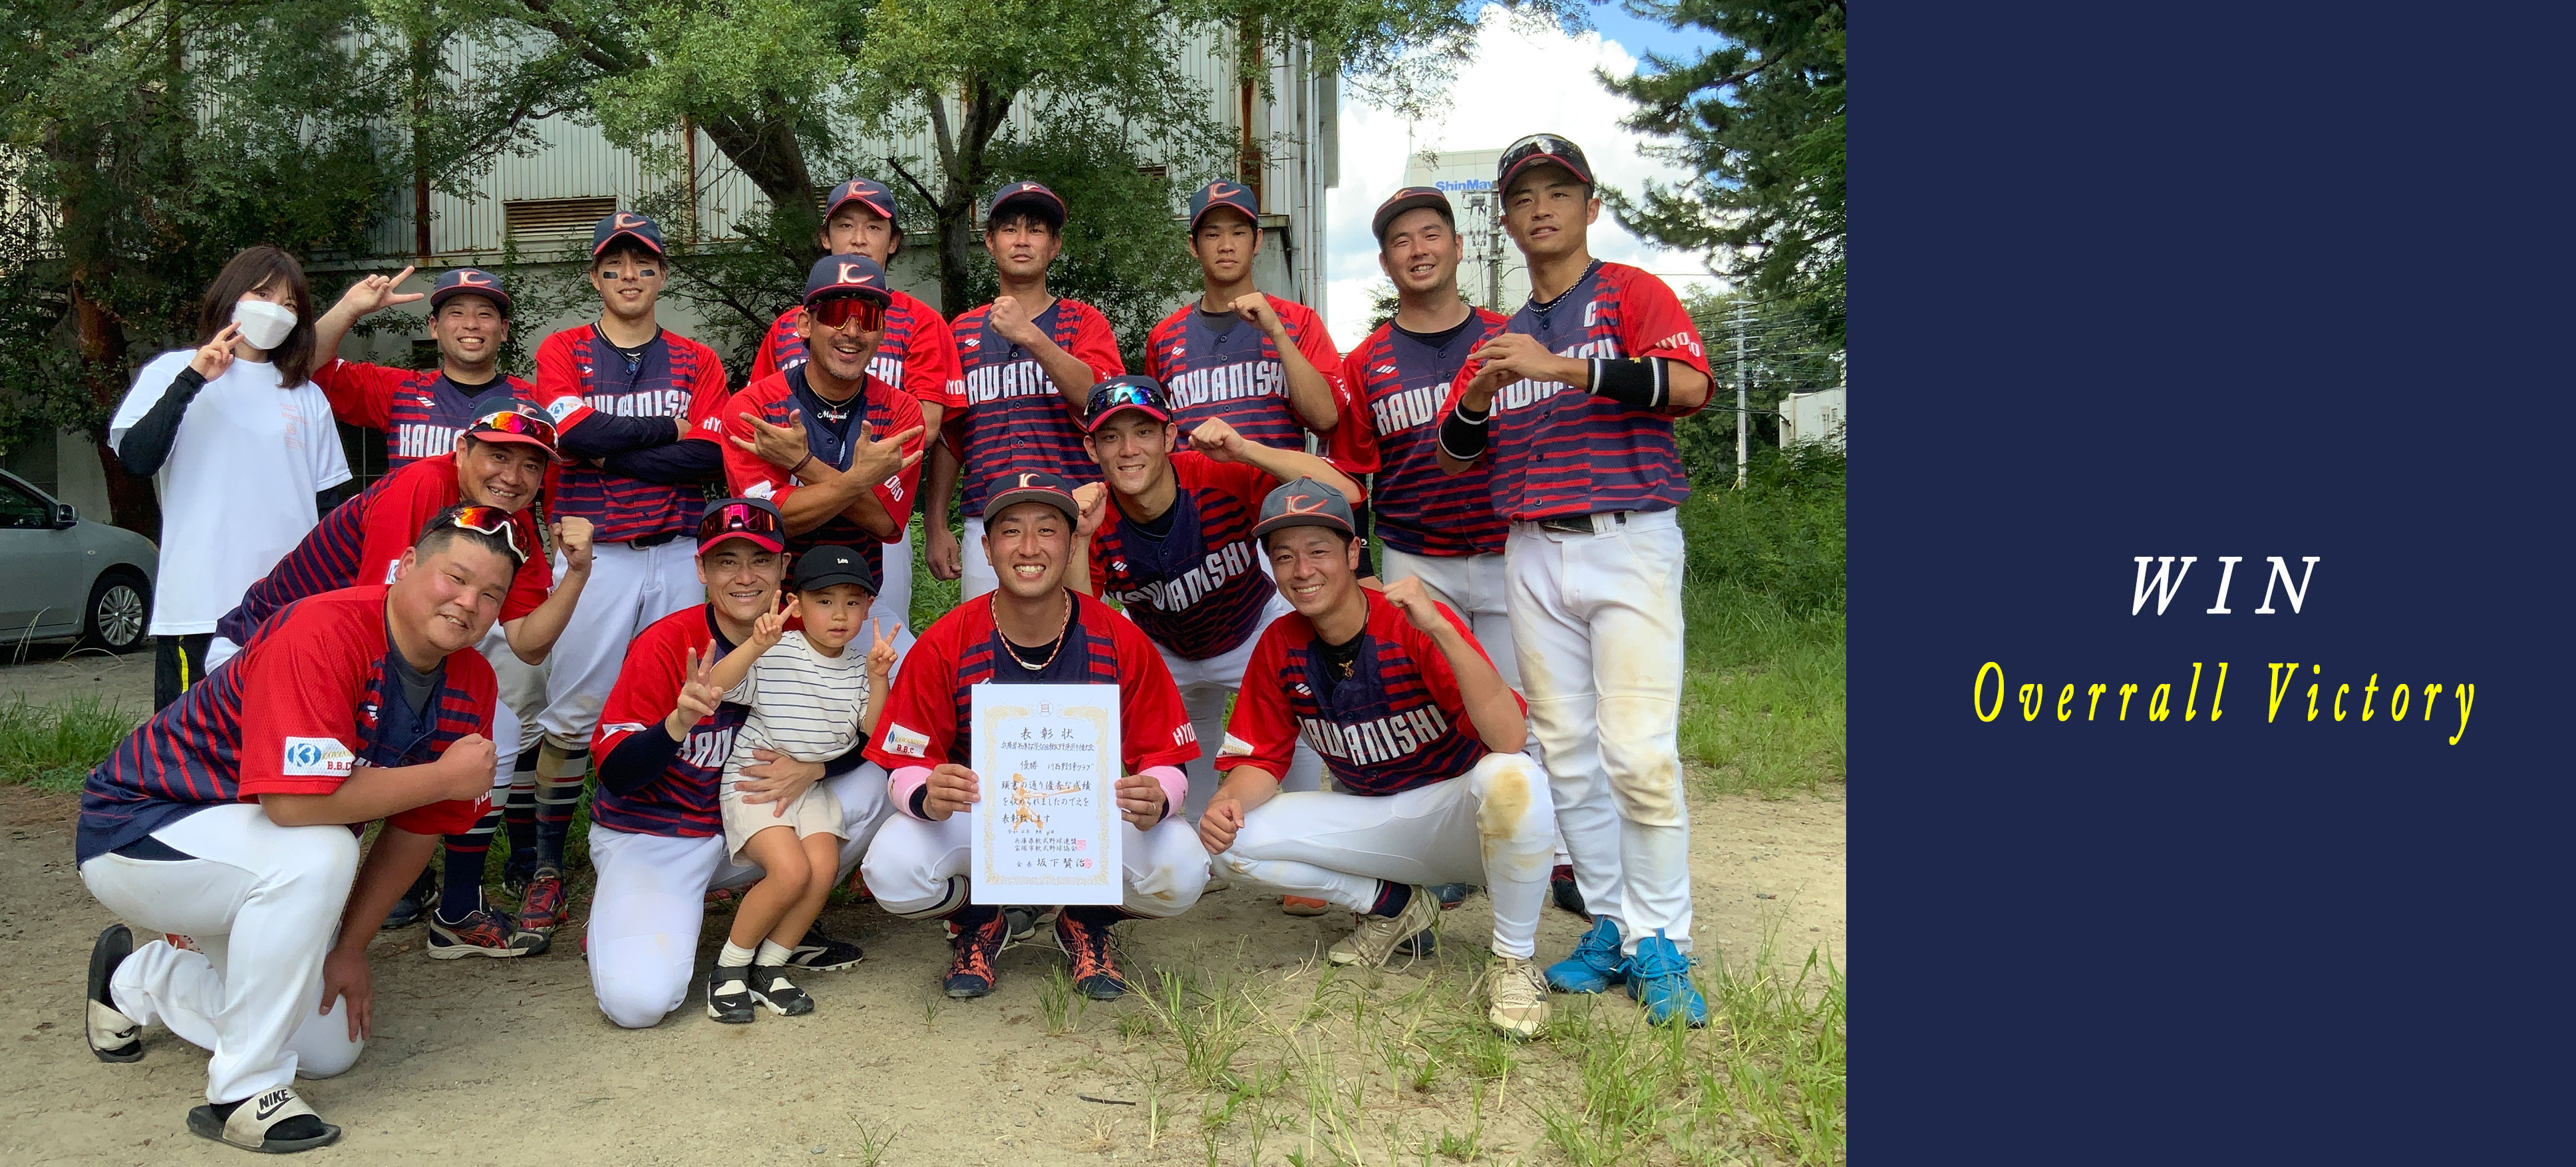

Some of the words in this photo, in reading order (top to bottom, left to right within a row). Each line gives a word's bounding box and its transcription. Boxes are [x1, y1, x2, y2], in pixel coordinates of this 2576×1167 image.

[1583, 301, 1597, 328] C
[703, 416, 723, 434] HY
[1021, 727, 1074, 741] 表彰状
[1172, 722, 1198, 747] HYO
[1296, 704, 1448, 766] AWANISHI
[1020, 760, 1039, 770] 優勝
[1001, 812, 1050, 824] 表彰致します
[1037, 858, 1085, 869] 坂下賢治
[259, 1088, 289, 1111] NIKE
